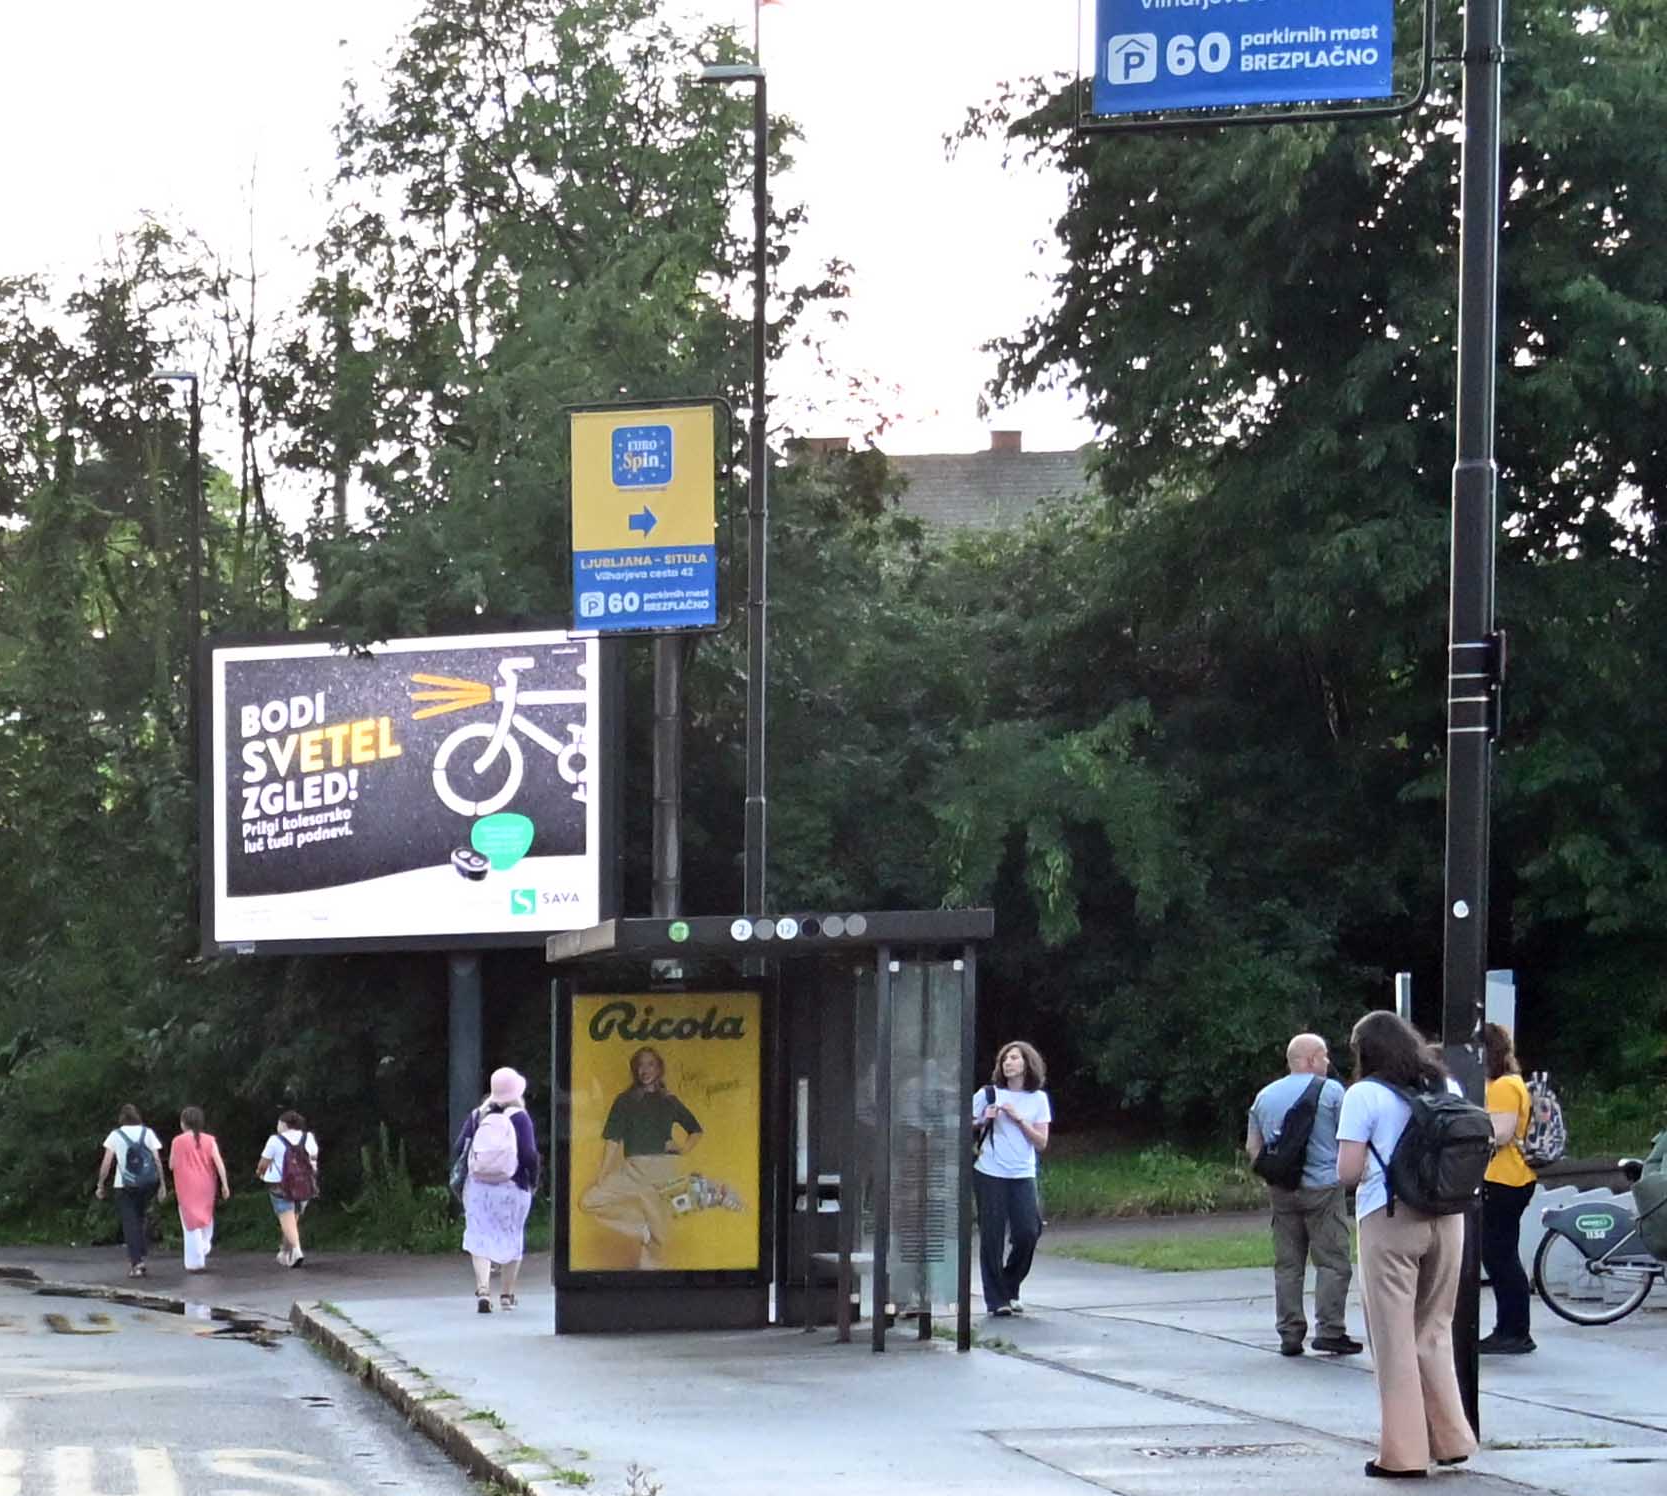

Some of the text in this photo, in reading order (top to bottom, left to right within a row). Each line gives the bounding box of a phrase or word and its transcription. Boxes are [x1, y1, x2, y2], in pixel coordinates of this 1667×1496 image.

[1241, 25, 1379, 51] parkirnih mest
[1166, 32, 1231, 76] 60
[1240, 47, 1379, 72] BREZPLAČNO
[623, 452, 660, 473] Spin
[580, 556, 652, 570] LJUBLJANA
[664, 552, 708, 565] SITULA
[595, 567, 694, 582] Vilharjeva cesta 42
[608, 591, 640, 614] 60
[643, 598, 710, 612] BREZPLAČNO
[241, 691, 326, 738] BODI
[242, 716, 403, 783] SVETEL
[241, 769, 360, 820] ZGLED!
[242, 808, 353, 838] Prižgi kolesarsko
[244, 822, 354, 854] luč tudi podnevi.
[542, 892, 580, 905] SAVA
[588, 1001, 747, 1041] Ricola
